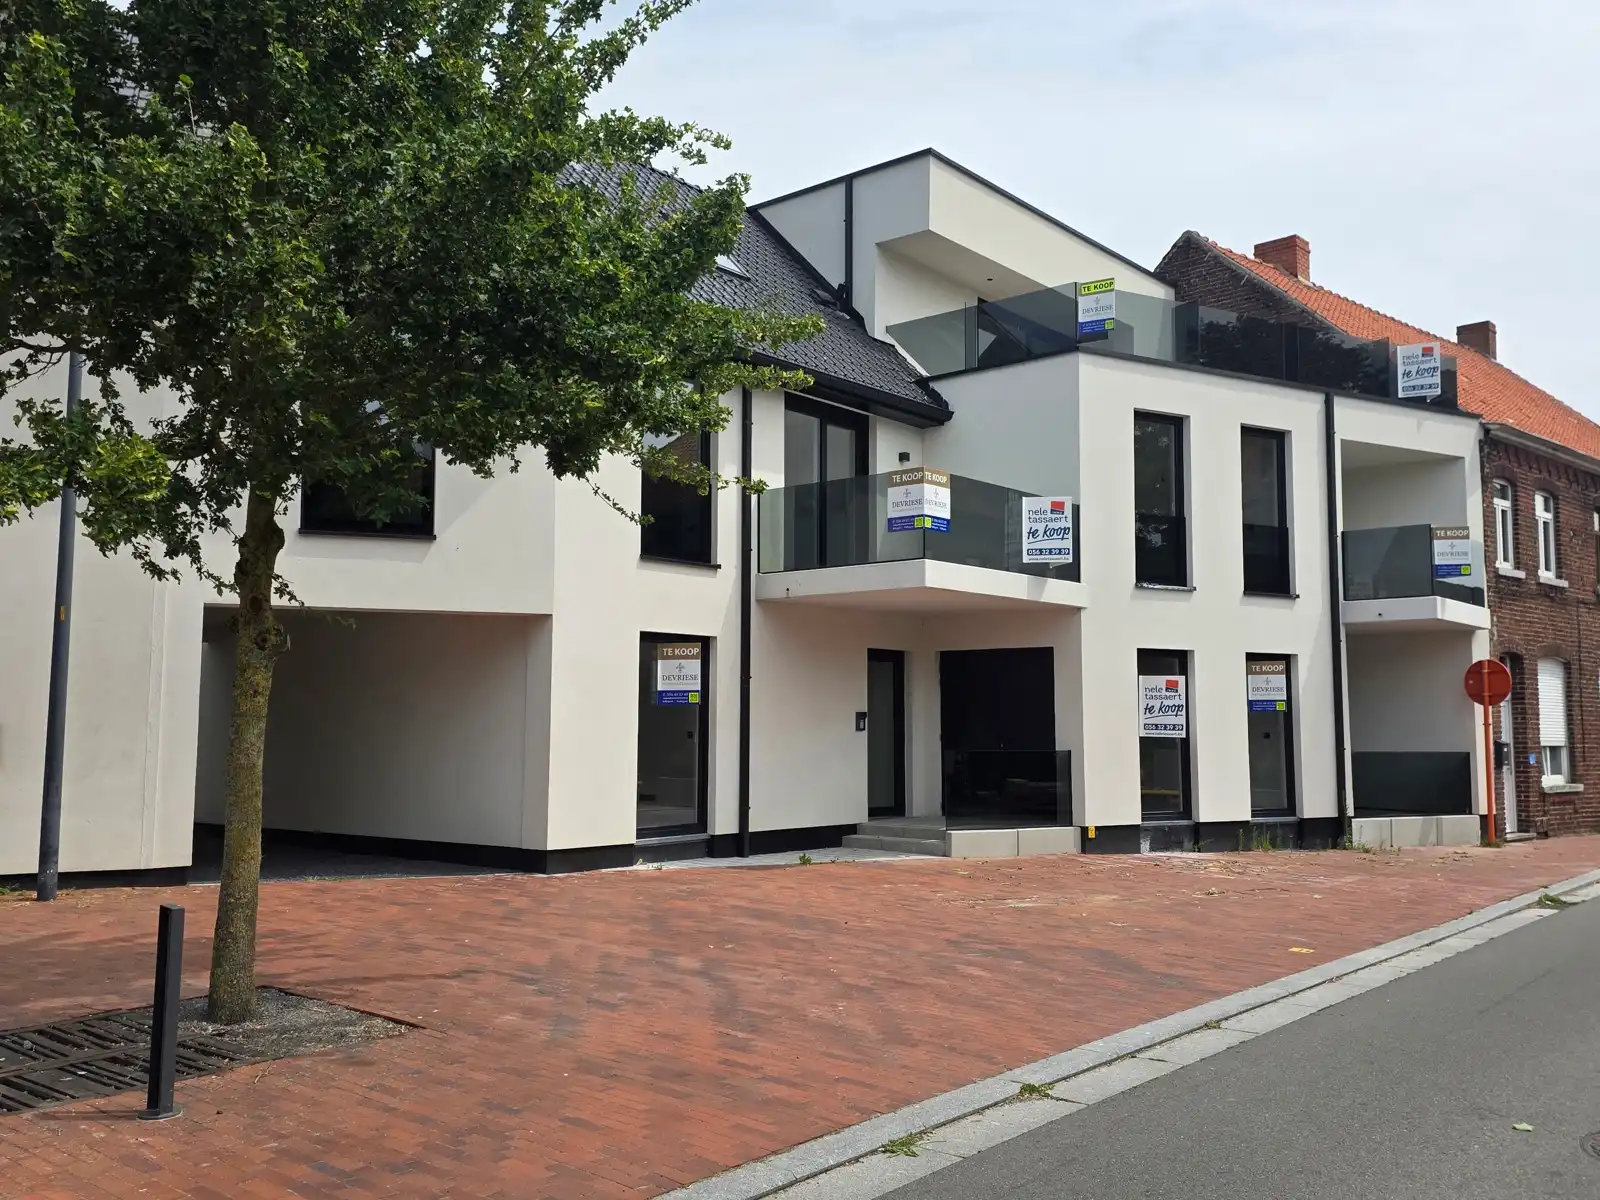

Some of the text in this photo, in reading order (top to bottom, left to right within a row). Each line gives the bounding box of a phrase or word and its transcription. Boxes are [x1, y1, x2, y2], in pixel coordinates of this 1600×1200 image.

[1082, 281, 1114, 293] TE KOOP
[1401, 365, 1439, 380] te koop
[892, 471, 924, 483] TE KOOP
[924, 471, 948, 484] TE KOOP
[892, 498, 923, 509] DEVRIESE
[1027, 506, 1048, 516] nele
[1027, 515, 1069, 524] tassaert
[1027, 524, 1071, 541] te koop
[1446, 529, 1469, 537] KOOP
[662, 647, 700, 656] TE KOOP
[1262, 664, 1284, 672] KOOP
[1144, 685, 1164, 694] nele
[1144, 693, 1183, 701] tassaert
[1143, 700, 1185, 718] te koop
